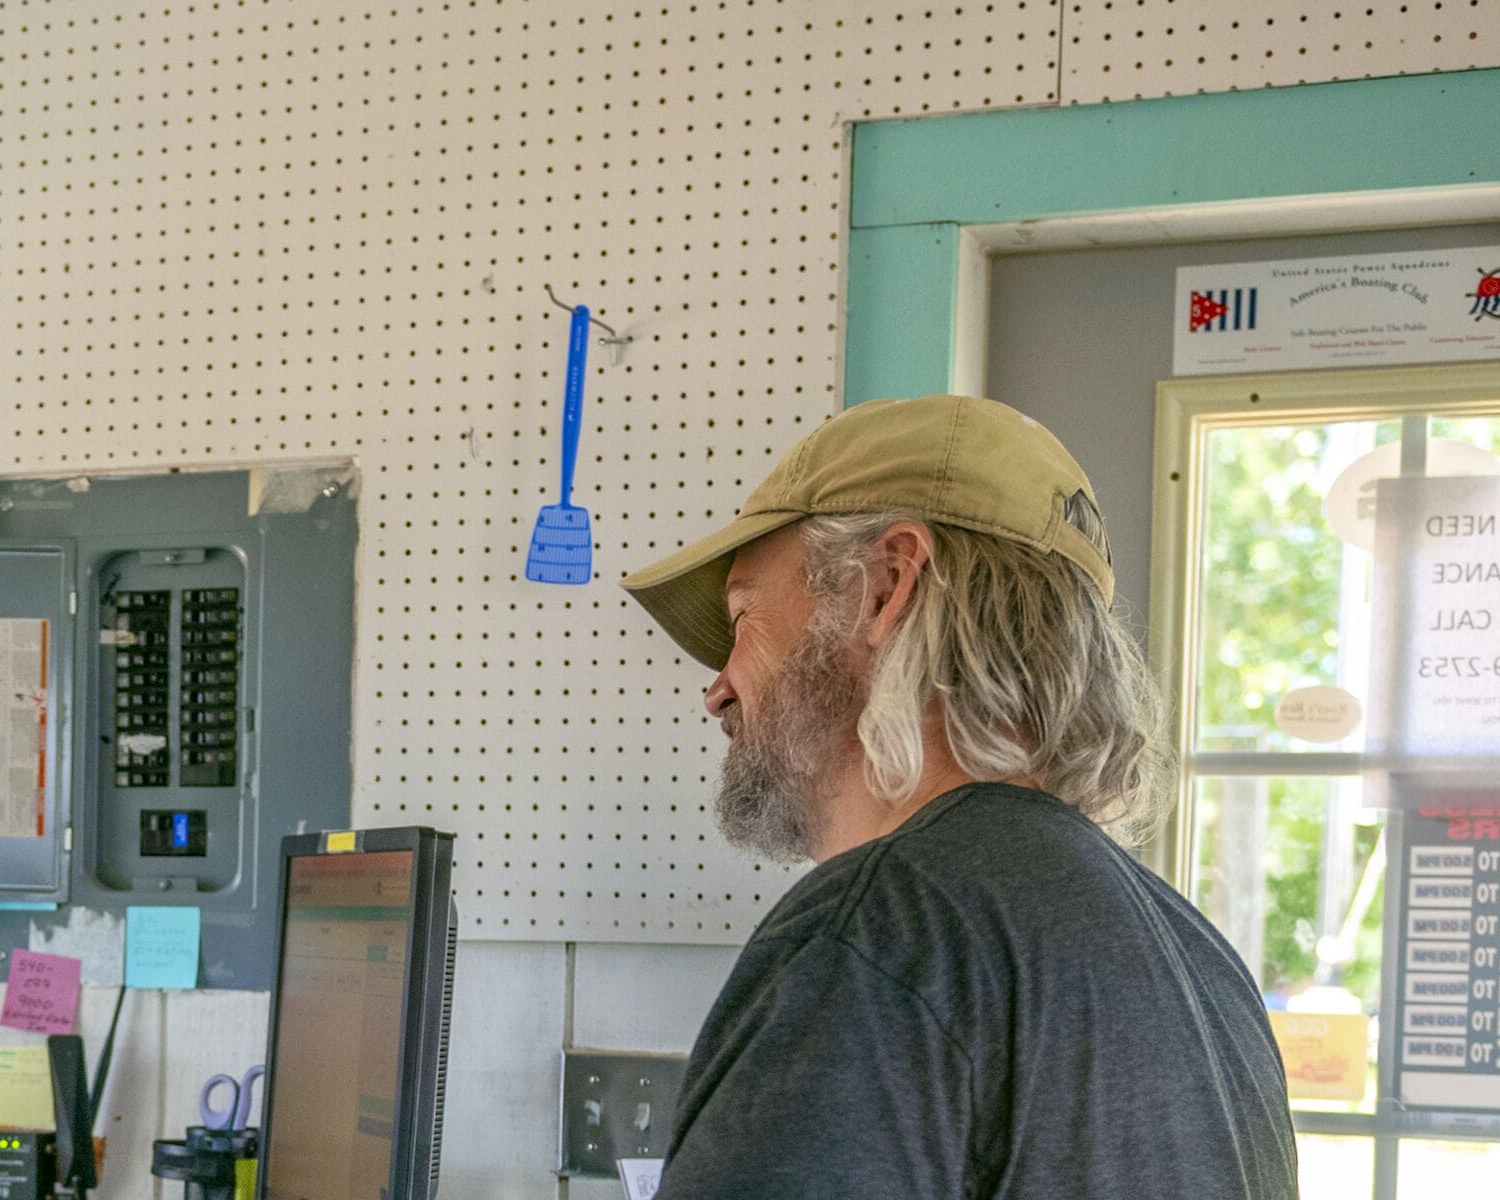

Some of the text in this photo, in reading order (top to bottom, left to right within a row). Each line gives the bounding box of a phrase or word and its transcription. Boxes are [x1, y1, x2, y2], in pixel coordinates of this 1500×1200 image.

[1272, 268, 1310, 278] United
[1315, 266, 1348, 275] States
[1391, 260, 1451, 272] Squadrons
[1289, 276, 1429, 307] America's Boating Club
